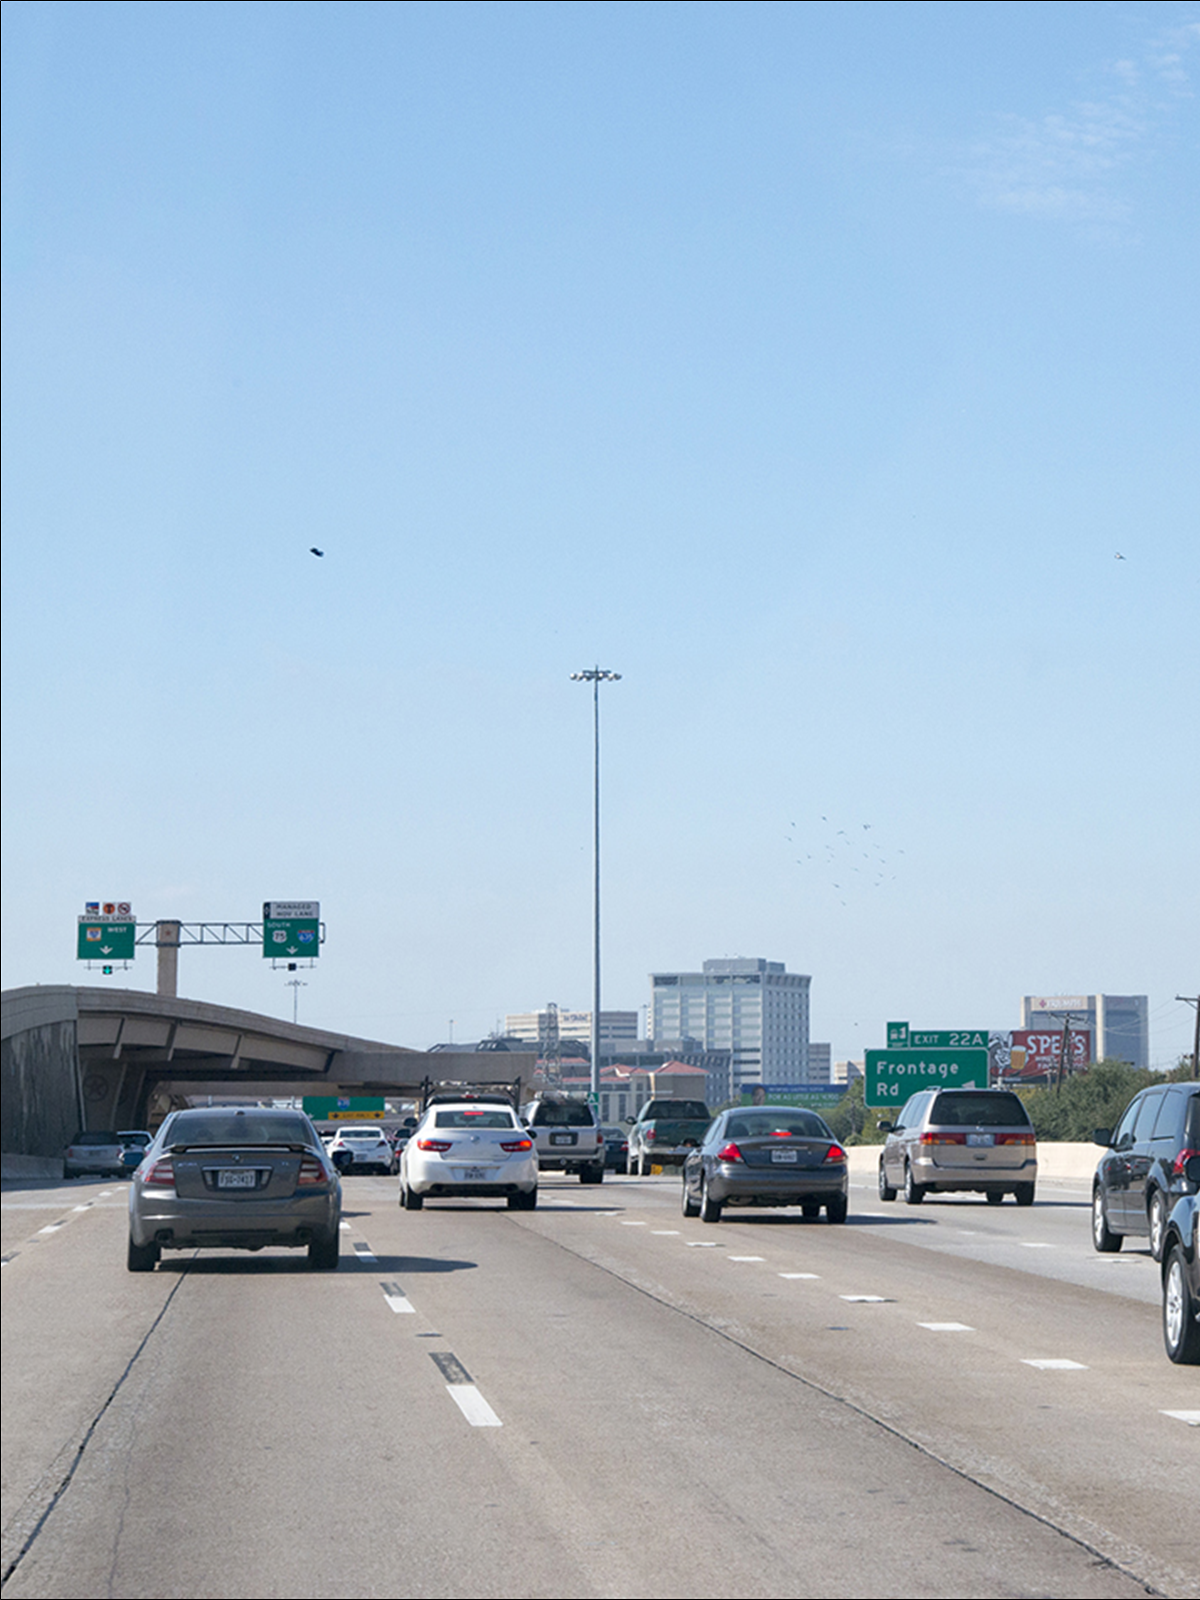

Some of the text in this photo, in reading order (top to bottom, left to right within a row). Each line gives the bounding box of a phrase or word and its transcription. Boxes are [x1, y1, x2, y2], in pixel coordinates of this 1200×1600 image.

[274, 932, 286, 940] 75
[914, 1033, 984, 1046] EXIT 22A
[1027, 1032, 1085, 1055] SPE'S
[876, 1061, 959, 1079] Frontage
[876, 1083, 899, 1096] Rd
